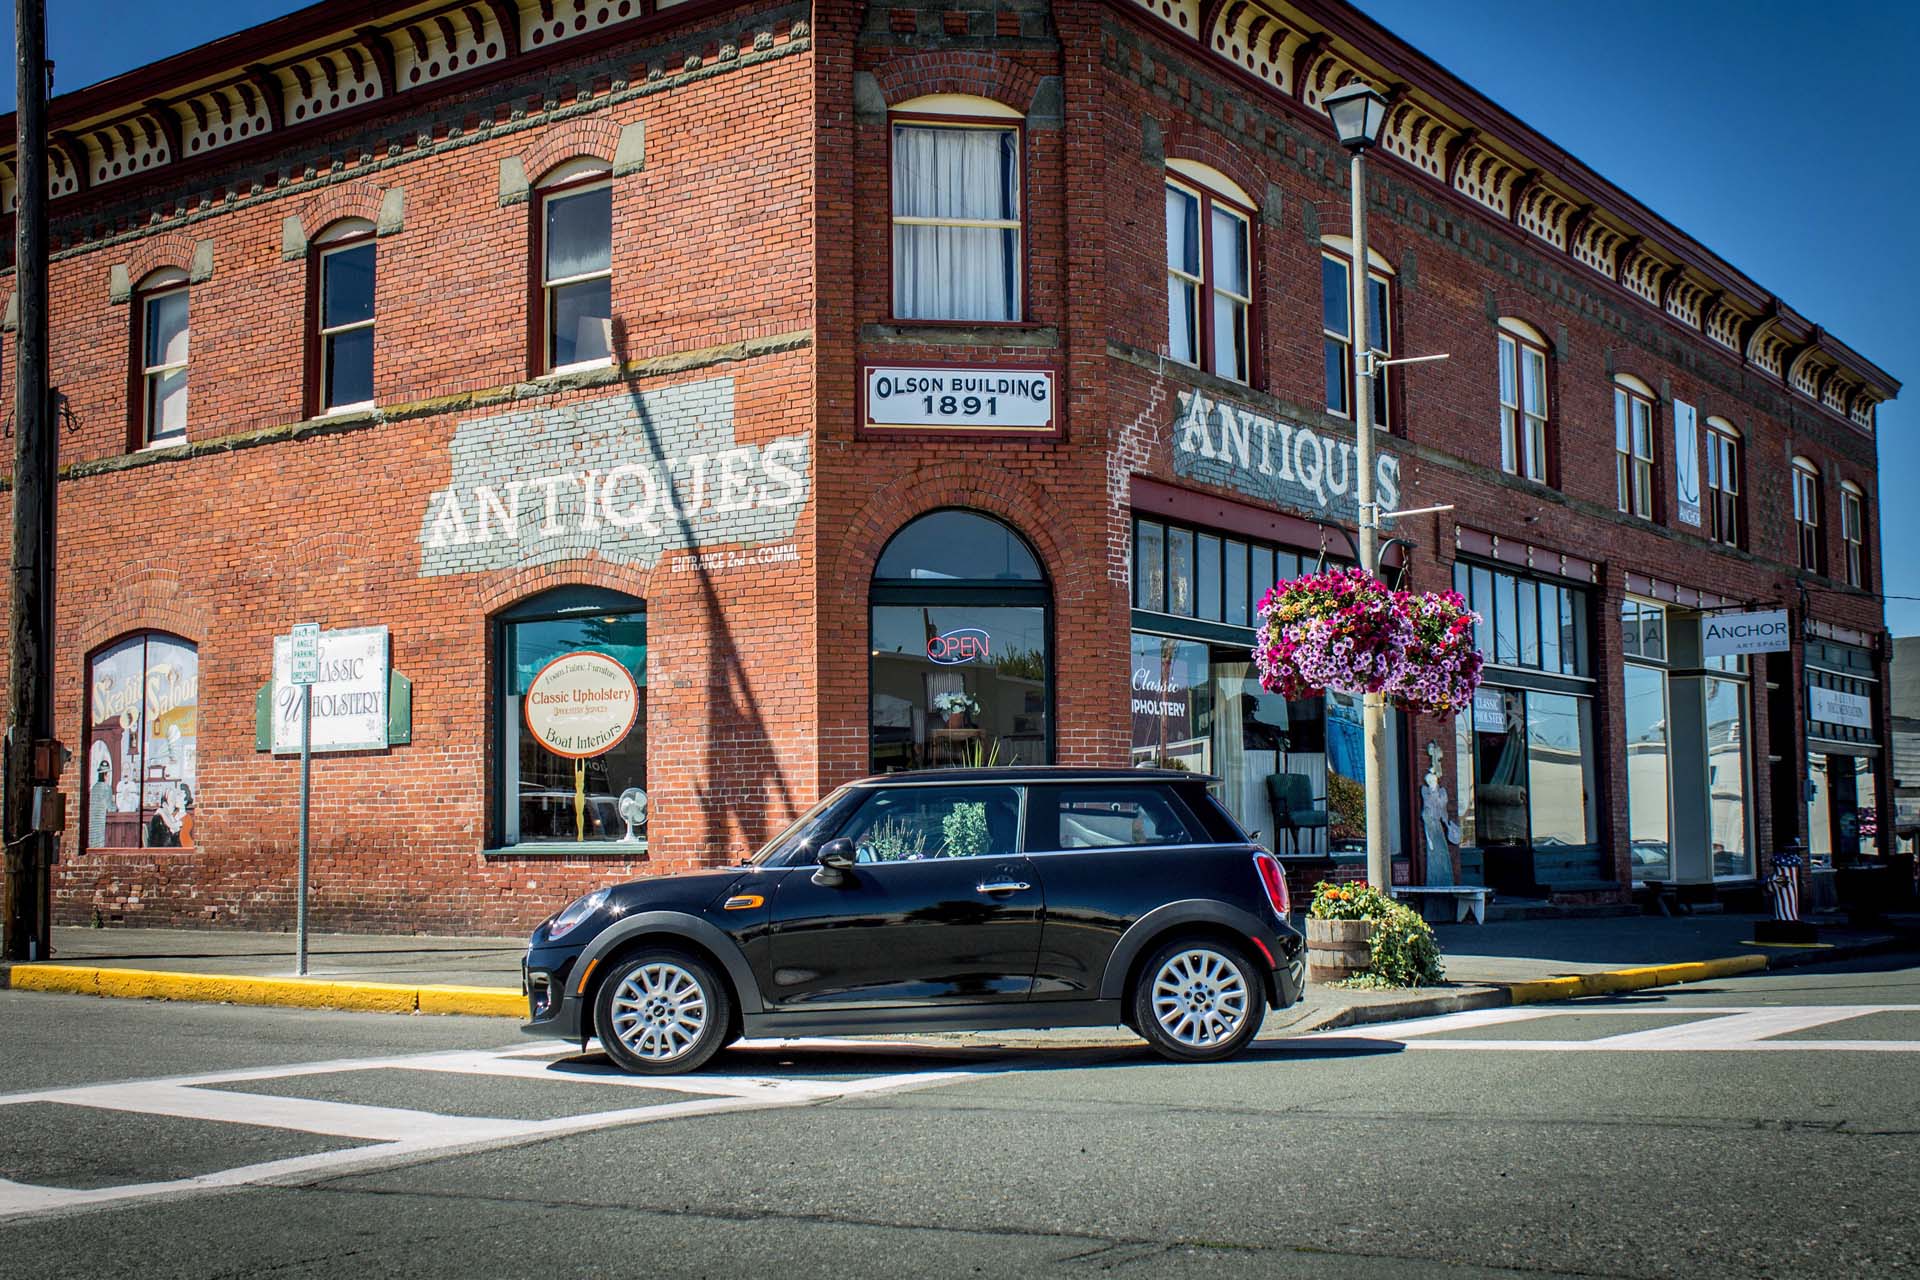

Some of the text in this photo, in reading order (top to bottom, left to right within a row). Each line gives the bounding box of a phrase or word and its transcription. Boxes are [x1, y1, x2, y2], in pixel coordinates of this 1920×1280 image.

[876, 376, 1047, 402] OLSON BUILDING
[922, 395, 998, 417] 1891
[1176, 387, 1401, 513] ANTIQUS
[426, 437, 808, 549] ANTIQUES
[671, 551, 725, 573] ENTRANCE
[727, 551, 746, 568] 2nd
[758, 544, 801, 564] COMML
[1705, 622, 1787, 640] ANCHOR
[927, 636, 989, 658] OPEN
[1736, 640, 1787, 649] ART SPACE
[317, 646, 364, 683] LASSIC
[1132, 667, 1180, 693] Classic
[278, 686, 381, 722] UHOLSTERY
[531, 687, 631, 705] Classic Upholstery
[545, 722, 622, 750] Boat Interiors
